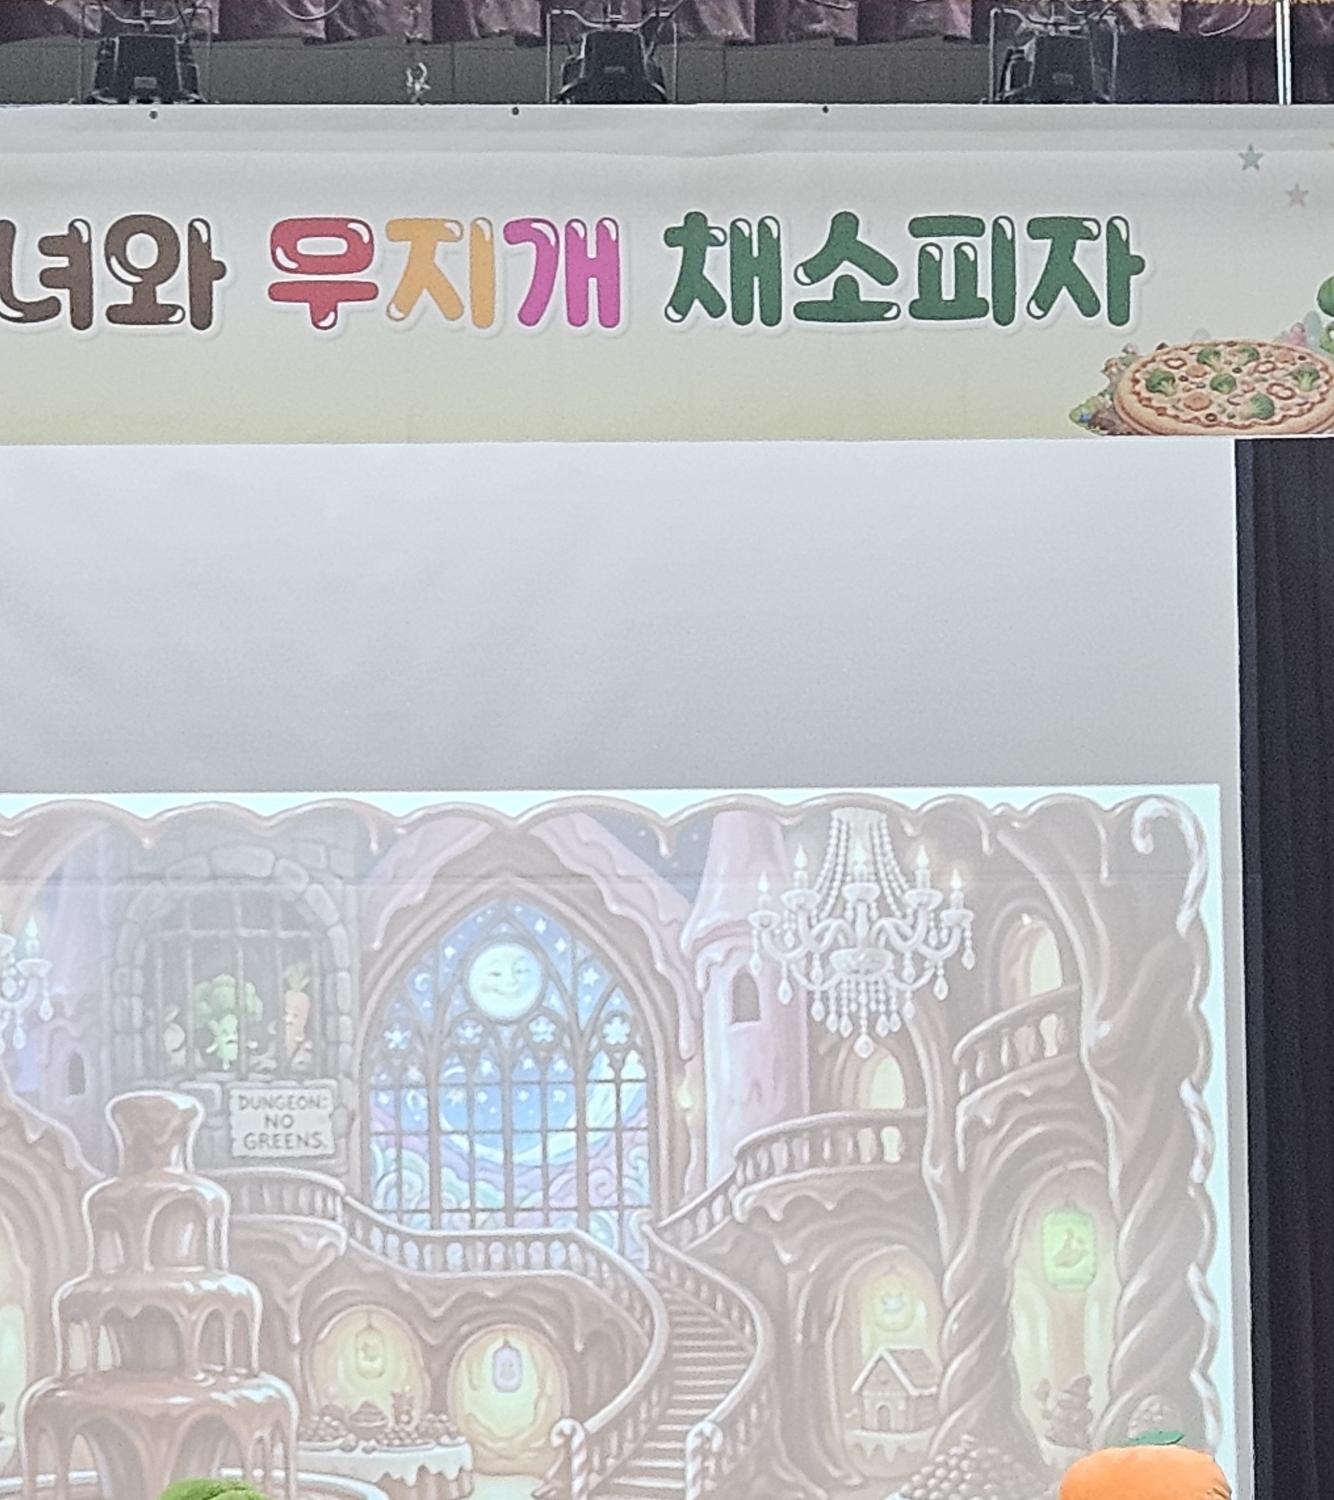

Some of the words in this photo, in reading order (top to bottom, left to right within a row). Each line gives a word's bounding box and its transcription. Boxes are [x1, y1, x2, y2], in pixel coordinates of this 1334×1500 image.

[267, 215, 622, 331] 무지개
[663, 210, 1146, 328] 채소피자
[265, 1114, 295, 1129] NO
